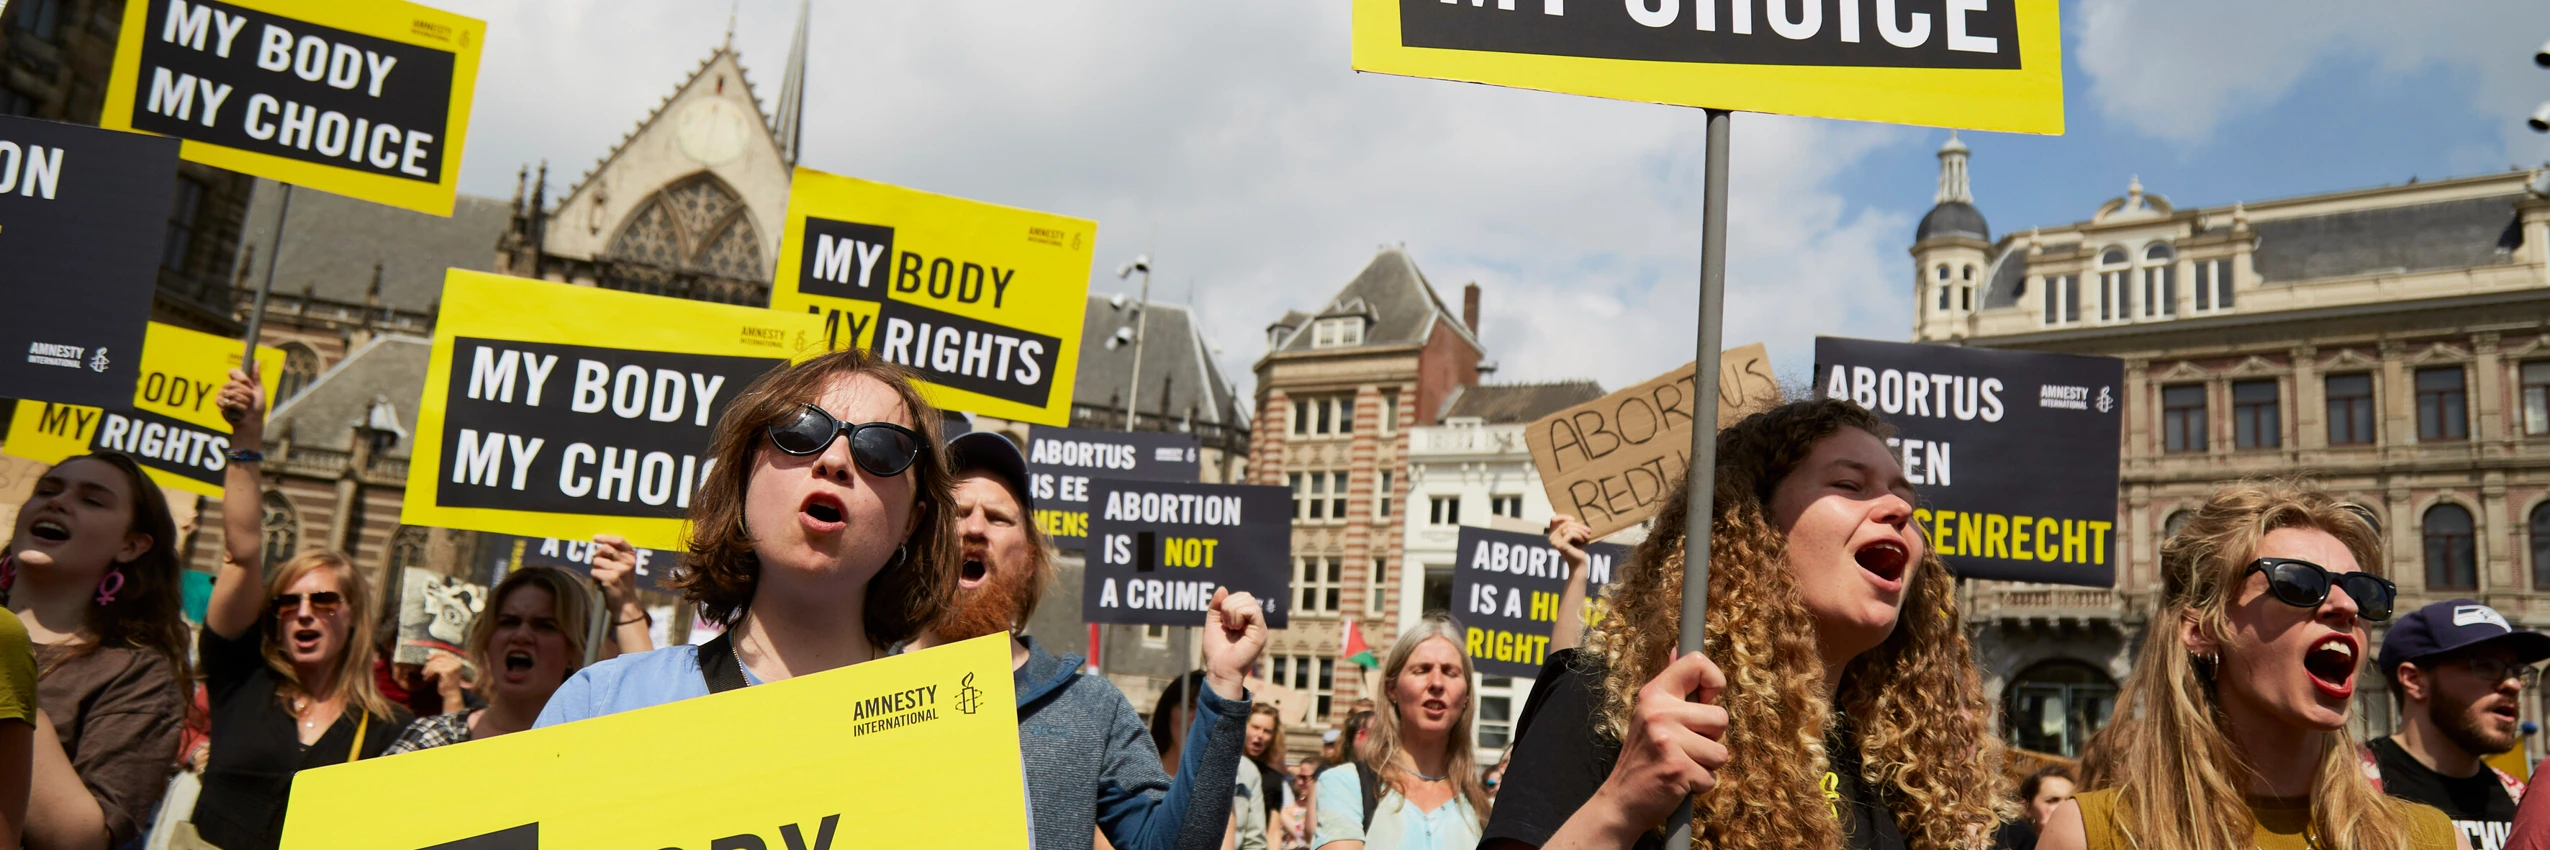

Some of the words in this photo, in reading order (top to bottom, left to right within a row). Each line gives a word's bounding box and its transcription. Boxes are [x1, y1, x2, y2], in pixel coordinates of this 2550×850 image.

[162, 0, 248, 58] MY
[256, 23, 398, 98] BODY
[146, 66, 234, 128] MY
[243, 93, 434, 178] CHOICE
[812, 233, 885, 289] MY
[895, 250, 1015, 309] BODY
[28, 354, 81, 369] INTERNATIONAL
[30, 341, 85, 360] AMNESTY
[881, 316, 1045, 387] RIGHTS
[143, 371, 214, 412] ODY
[467, 345, 560, 408] MY
[571, 358, 726, 427] BODY
[1827, 364, 2005, 424] ABORTUS
[2040, 398, 2089, 411] INTERNATIONAL
[2041, 384, 2090, 401] AMNESTY
[37, 403, 95, 440] MY
[100, 413, 231, 472] RIGHTS
[1031, 438, 1137, 470] ABORTUS
[451, 428, 545, 491] MY
[1886, 437, 1951, 487] EN
[1031, 473, 1055, 500] IS
[1568, 455, 1671, 528] REDT
[1104, 491, 1242, 527] ABORTION
[540, 537, 560, 558] A
[1104, 534, 1132, 565] IS
[1164, 537, 1219, 569] NOT
[1471, 539, 1612, 585] ABORTN
[1099, 577, 1119, 609] A
[1126, 578, 1215, 612] CRIME
[1469, 582, 1498, 615] IS
[1503, 587, 1523, 619] A
[1466, 626, 1550, 667] RIGHT
[852, 684, 938, 722] AMNESTY
[853, 708, 939, 738] INTERNATIONAL
